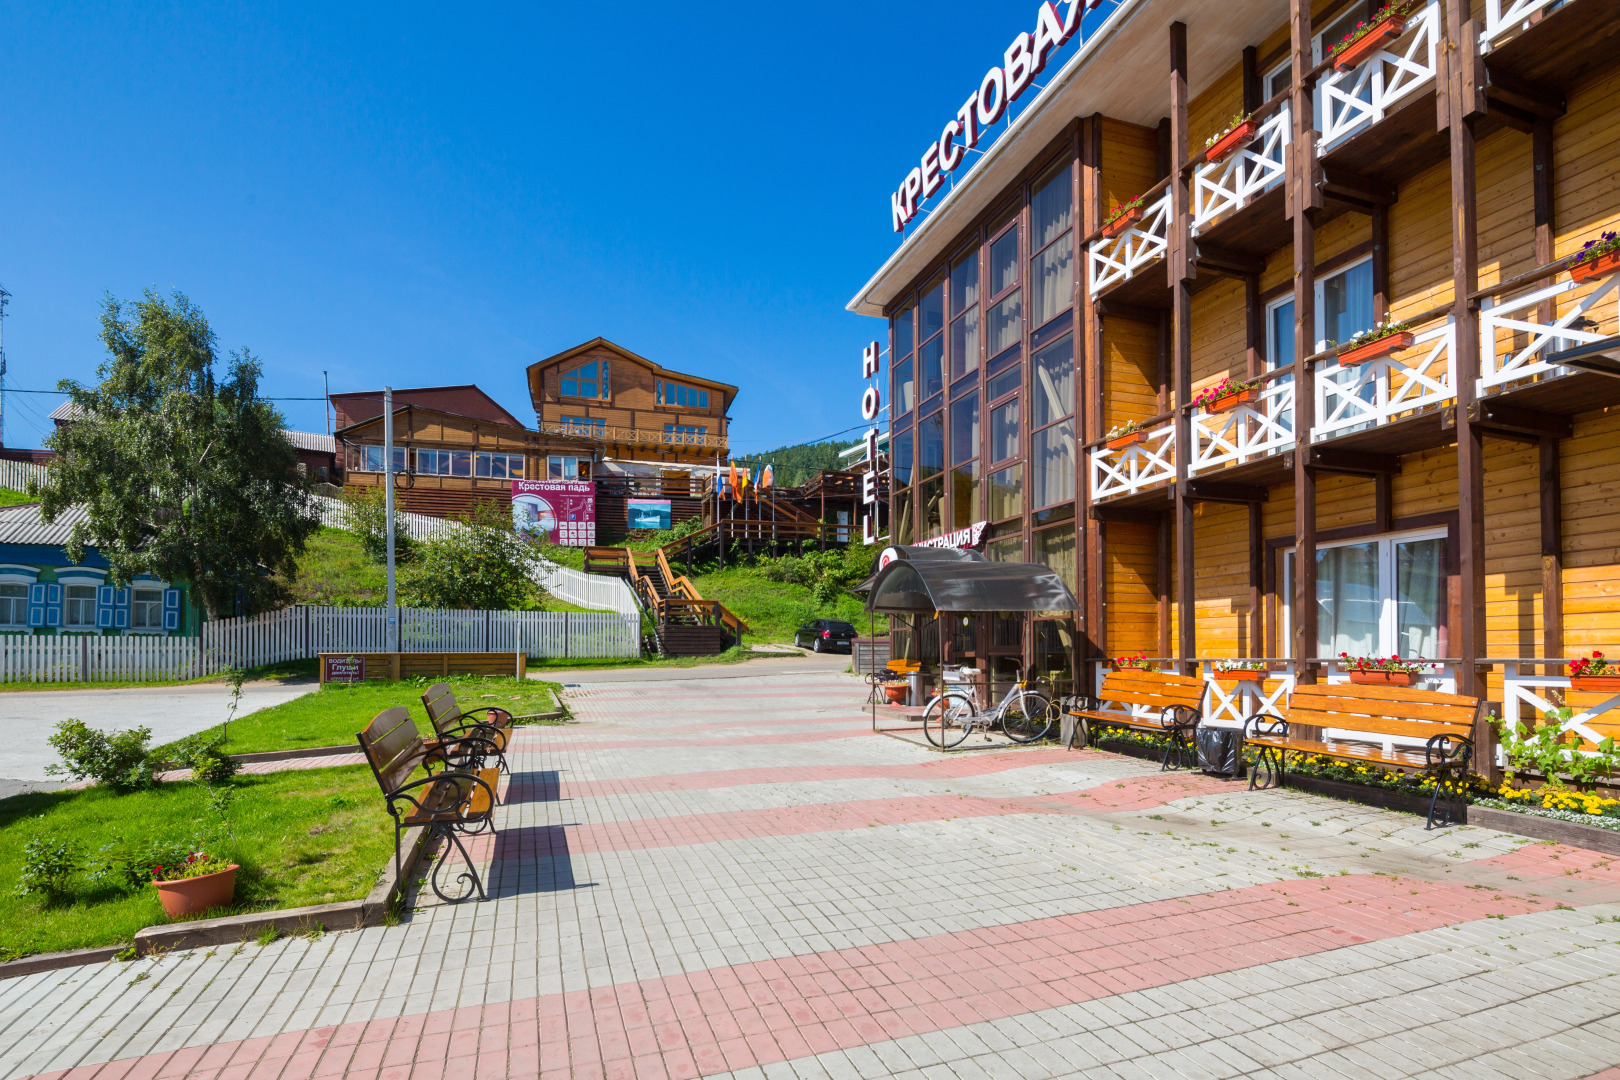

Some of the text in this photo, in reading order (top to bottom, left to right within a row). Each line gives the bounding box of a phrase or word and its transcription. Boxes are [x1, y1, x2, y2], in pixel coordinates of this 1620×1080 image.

[518, 481, 566, 492] Крестовая
[568, 483, 590, 493] падь
[862, 340, 879, 546] HOTEL
